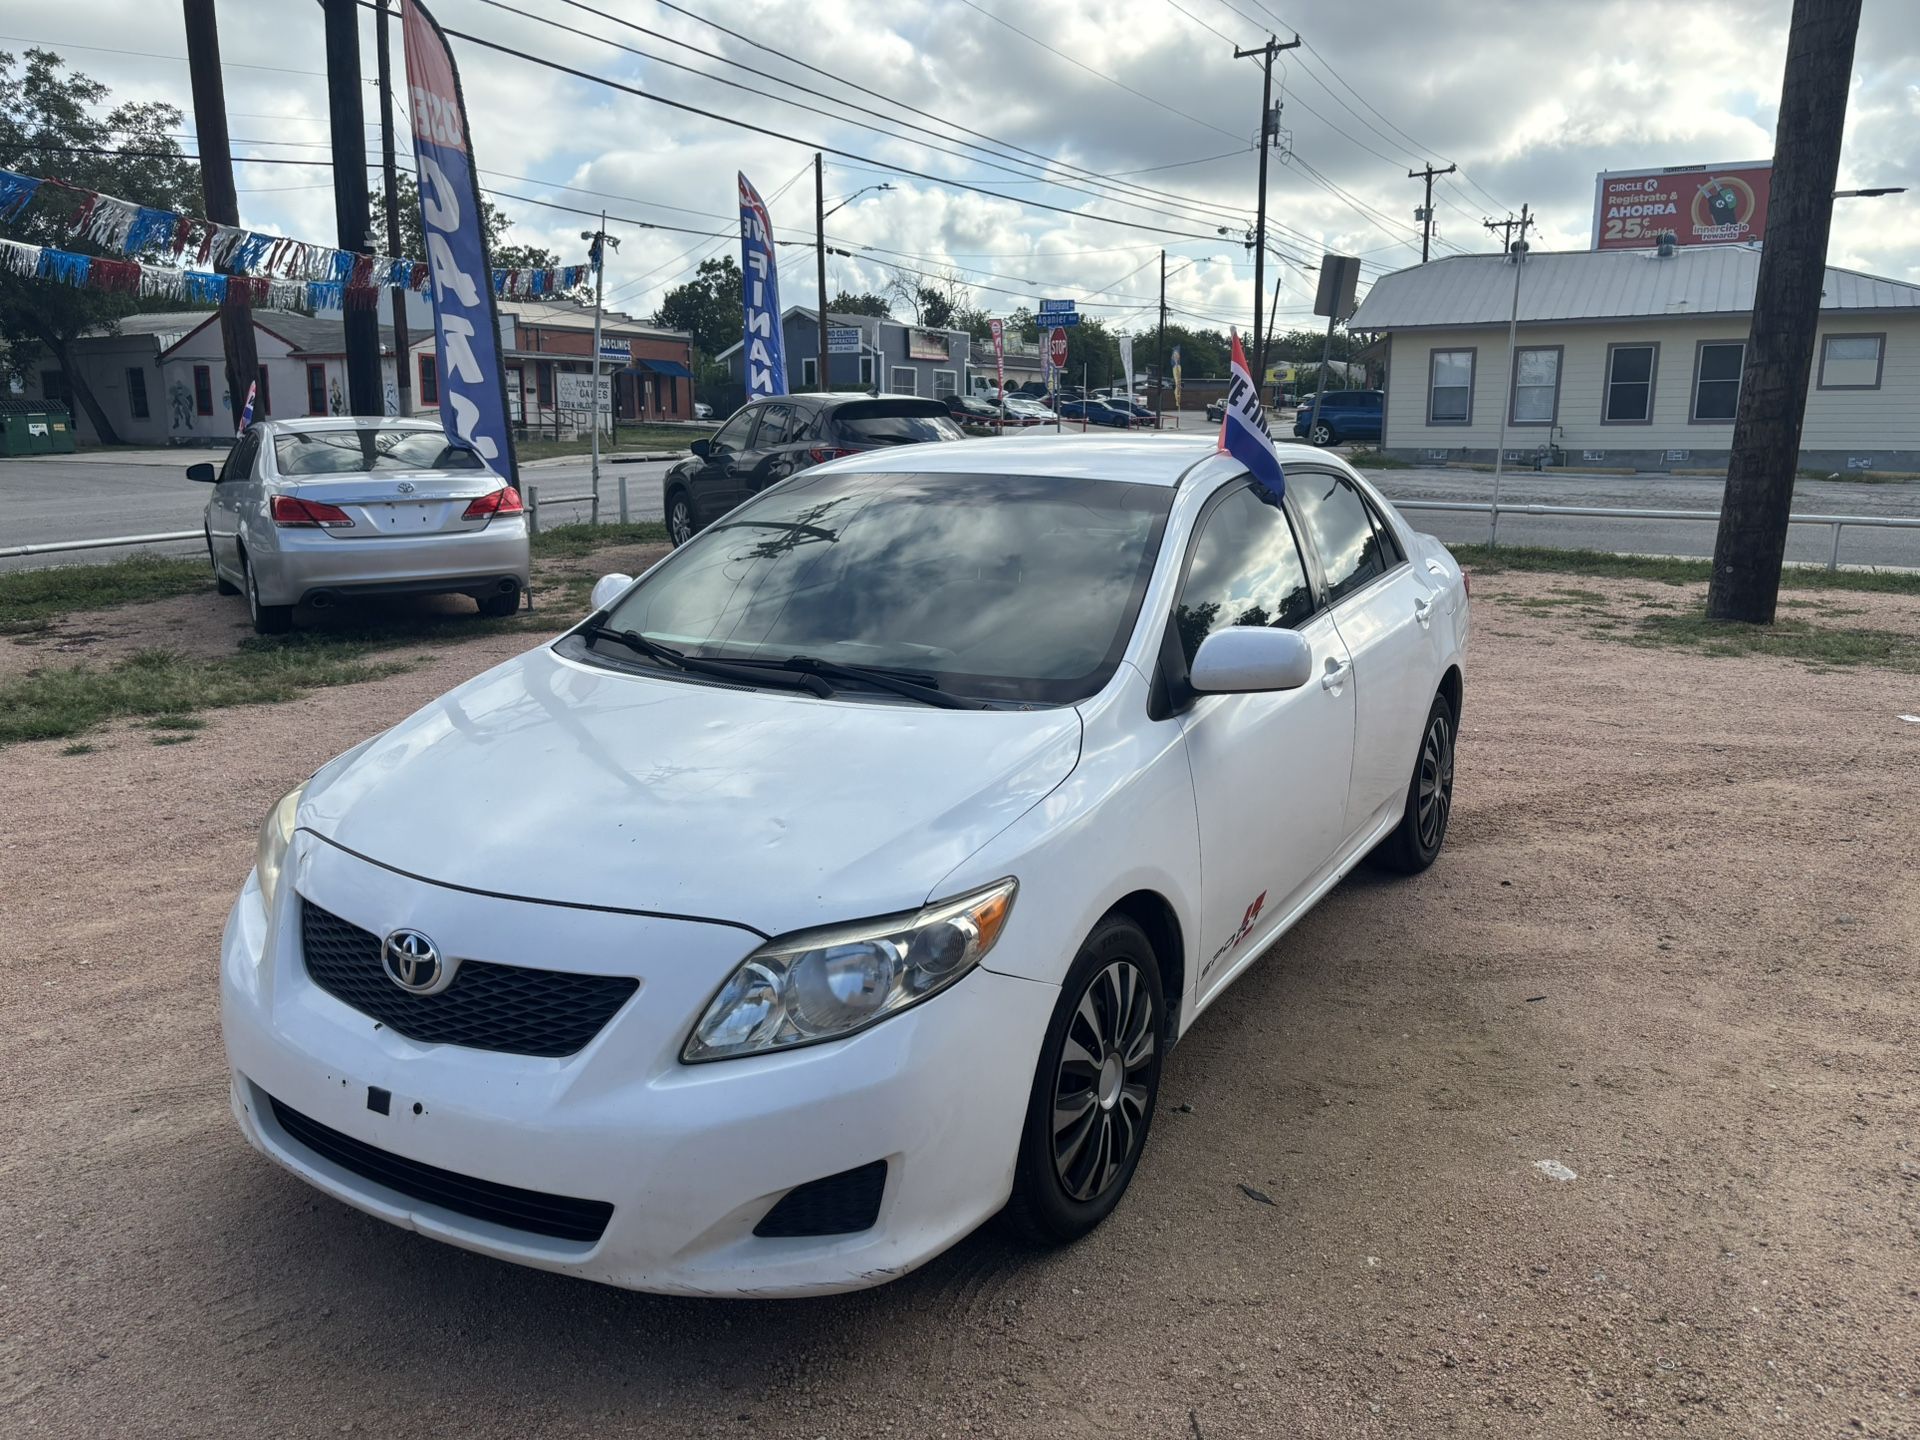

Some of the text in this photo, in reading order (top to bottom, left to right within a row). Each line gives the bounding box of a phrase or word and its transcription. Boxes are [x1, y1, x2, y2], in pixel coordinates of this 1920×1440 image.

[1609, 179, 1658, 192] CIRCLE K
[1670, 191, 1678, 200] &
[1607, 203, 1677, 218] AHORRA
[1693, 223, 1748, 235] innercircle
[1702, 231, 1739, 240] rewards
[1038, 315, 1066, 326] Aganier
[837, 329, 858, 337] CLINICS
[1051, 340, 1067, 355] STOP
[580, 389, 608, 399] GAES
